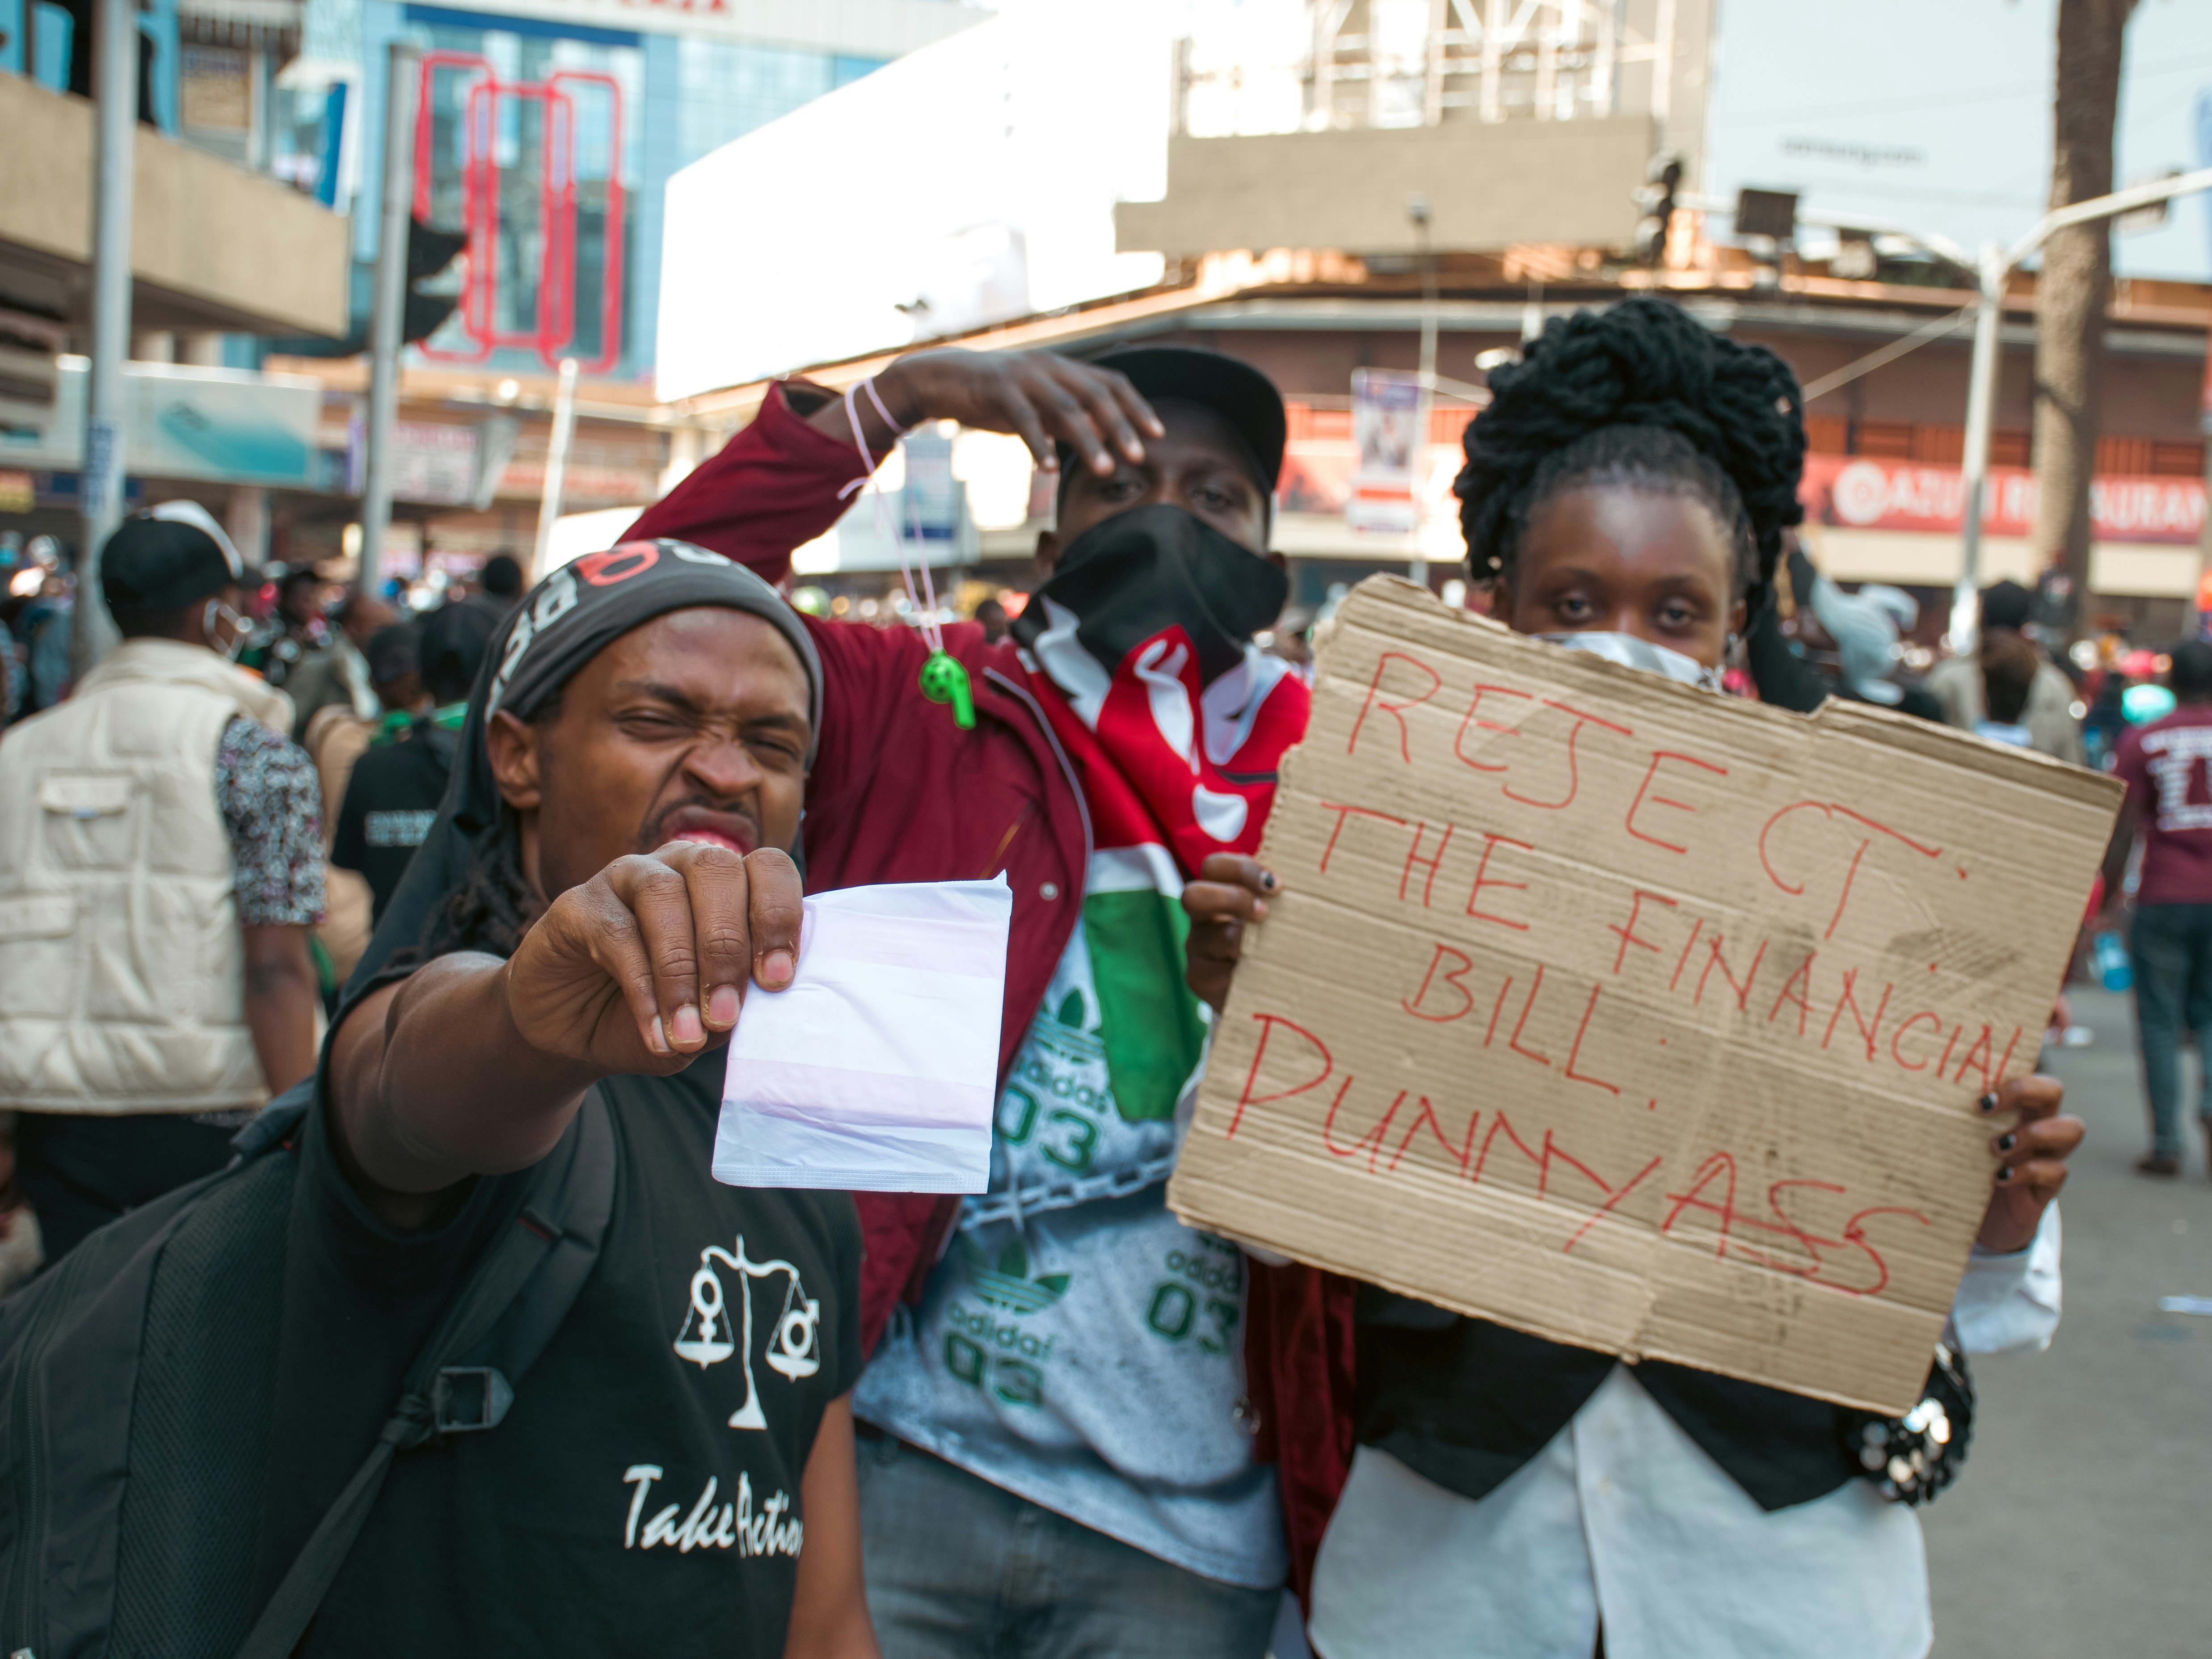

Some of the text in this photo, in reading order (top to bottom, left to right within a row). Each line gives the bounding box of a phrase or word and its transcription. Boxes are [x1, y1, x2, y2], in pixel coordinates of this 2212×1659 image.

[1320, 801, 1534, 931] THE
[993, 1082, 1097, 1172] 03
[1148, 1282, 1239, 1356] 03
[623, 1464, 736, 1554] Take
